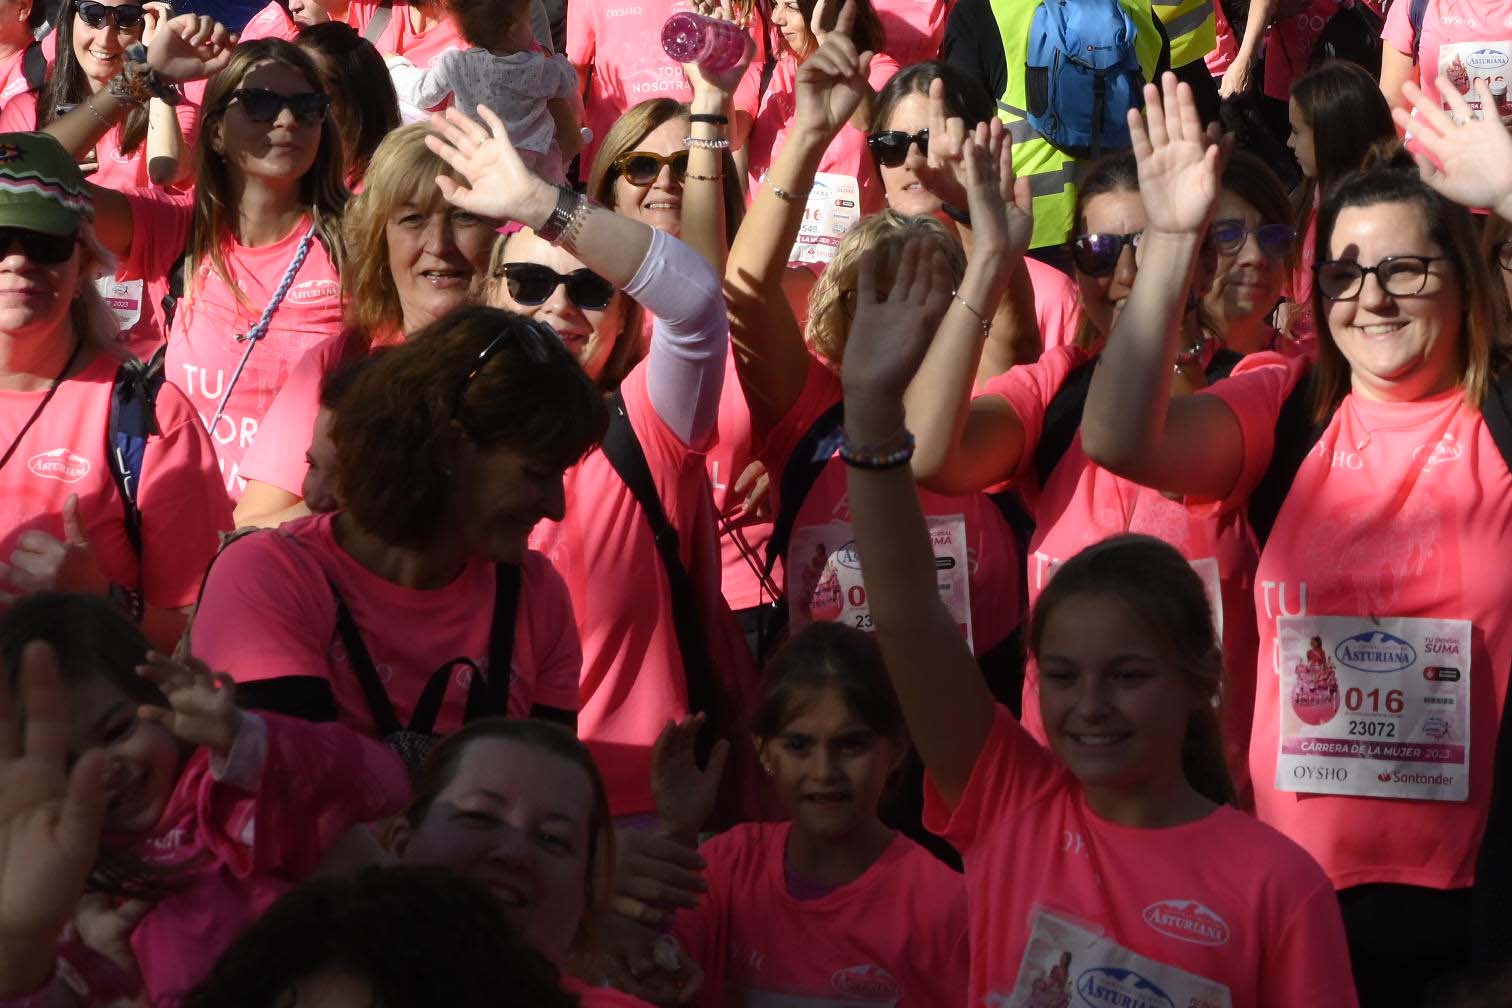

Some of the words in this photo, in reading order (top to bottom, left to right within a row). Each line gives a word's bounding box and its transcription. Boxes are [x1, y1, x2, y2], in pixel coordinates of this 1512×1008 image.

[1469, 55, 1506, 65] ASTURIANA
[657, 66, 688, 77] TOD
[804, 208, 824, 221] 16
[182, 363, 224, 400] TU
[1261, 581, 1308, 619] TU
[1341, 646, 1411, 665] ASTURIANA
[1424, 643, 1460, 655] SUMA
[1344, 687, 1405, 714] 016
[1349, 720, 1396, 738] 23072
[1301, 742, 1350, 753] CARRERA
[1351, 744, 1367, 754] DE
[1368, 746, 1382, 755] LA
[1384, 746, 1422, 757] MUJER
[1293, 765, 1348, 782] OYSHO
[1393, 772, 1454, 786] Santander
[1150, 907, 1223, 943] ASTURIANA
